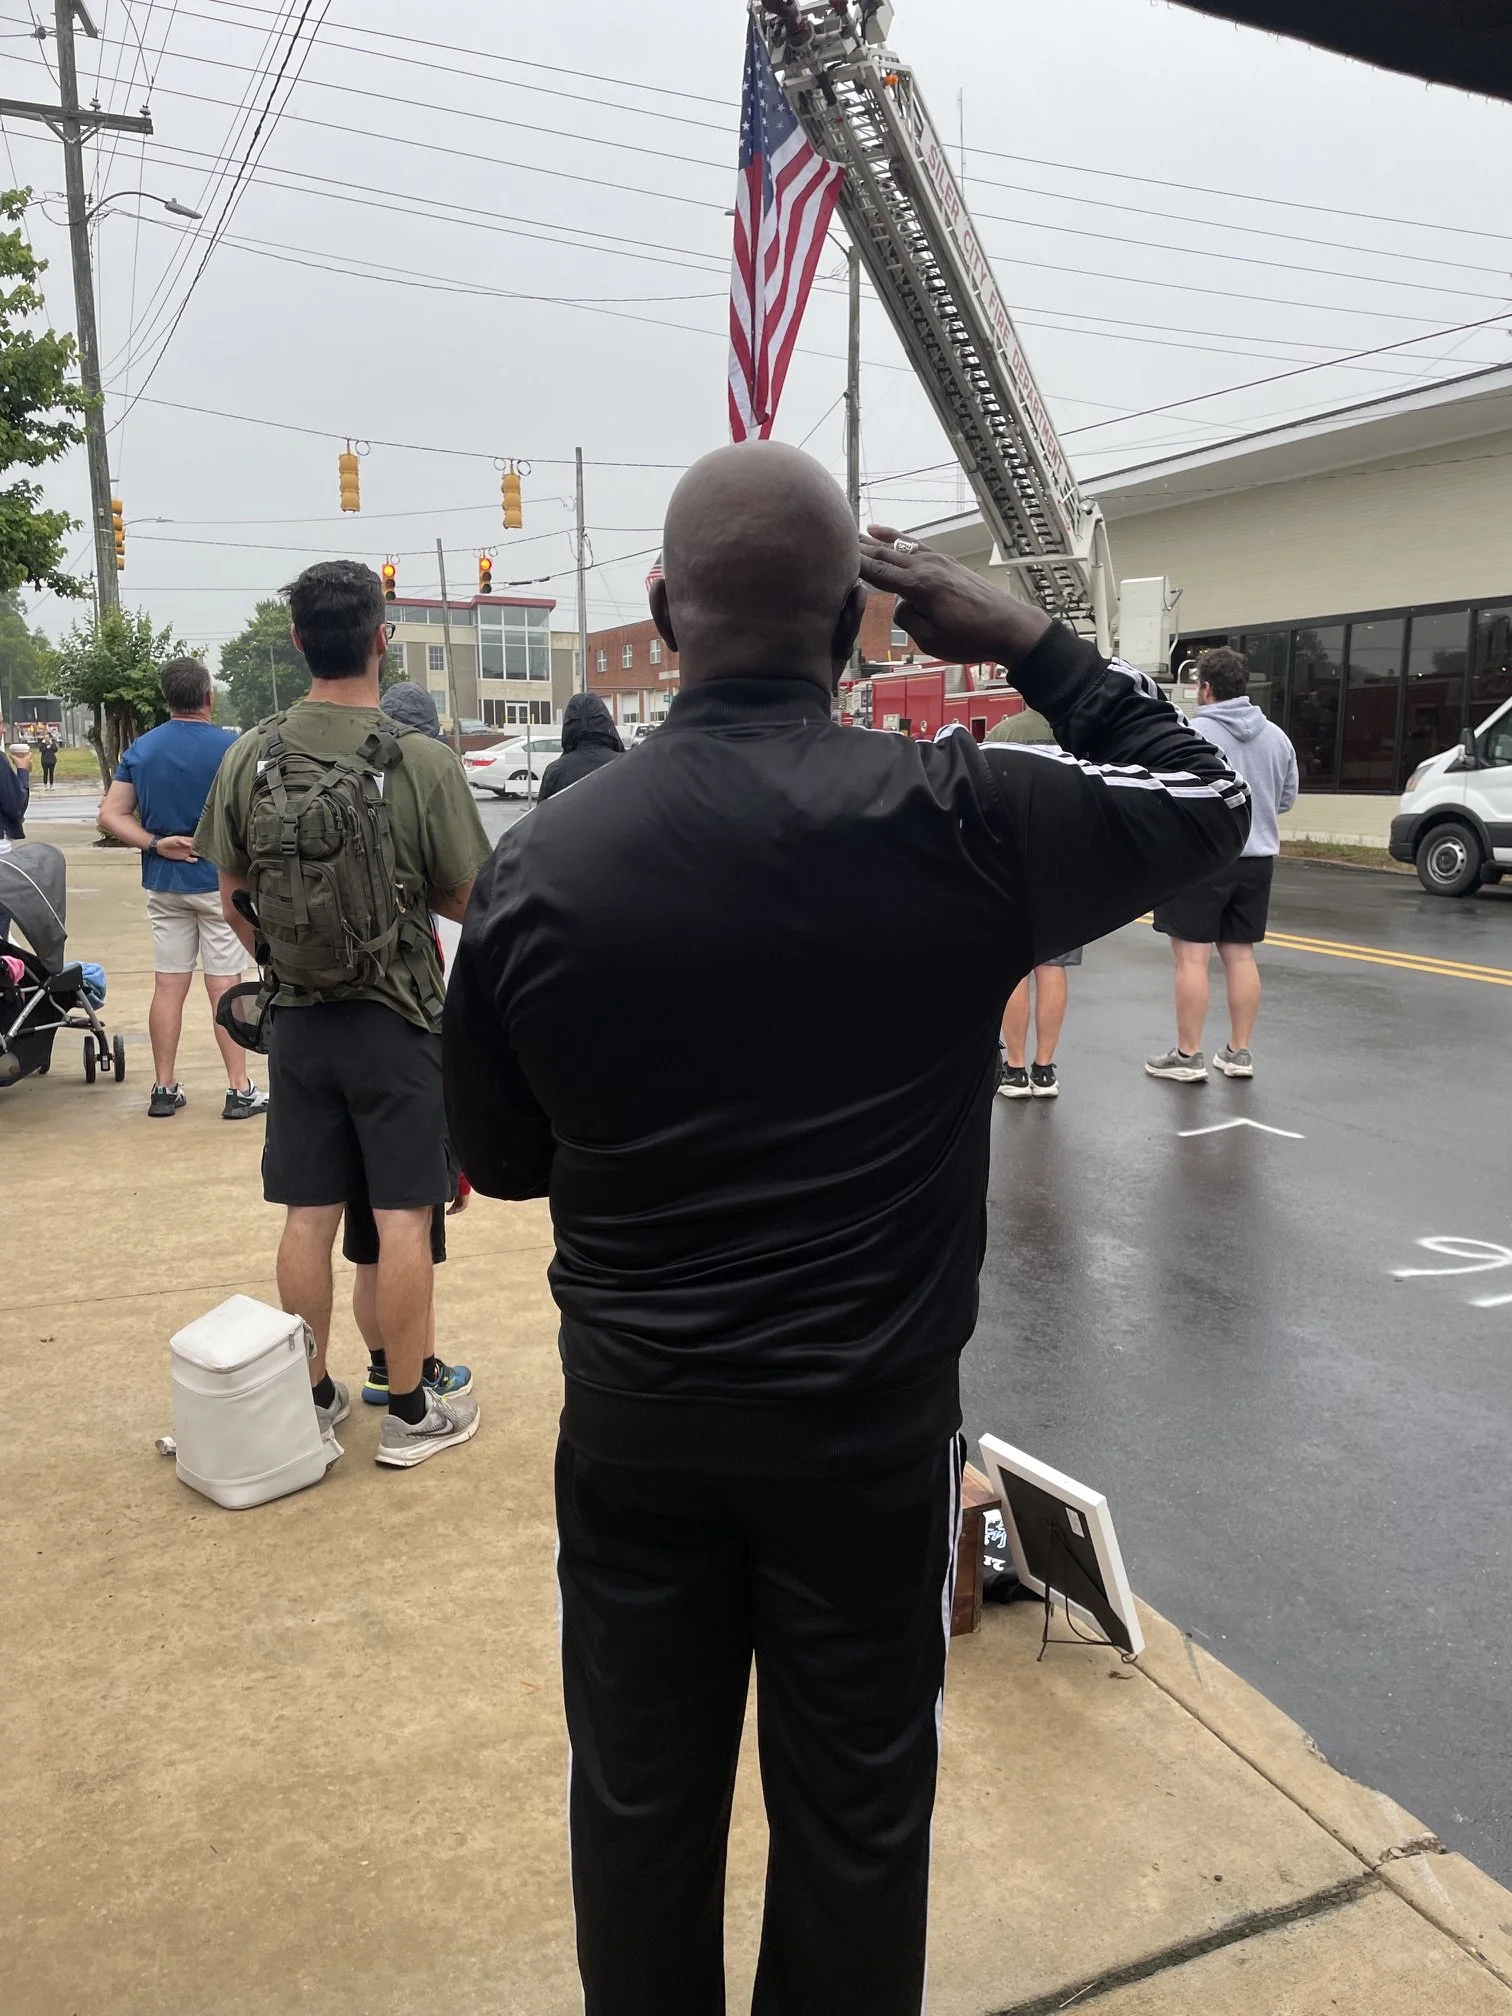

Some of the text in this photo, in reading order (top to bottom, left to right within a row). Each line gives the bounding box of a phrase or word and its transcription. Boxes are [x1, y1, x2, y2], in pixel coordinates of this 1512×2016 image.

[928, 144, 1062, 475] SILER CITY FIRE DEPARTMENT
